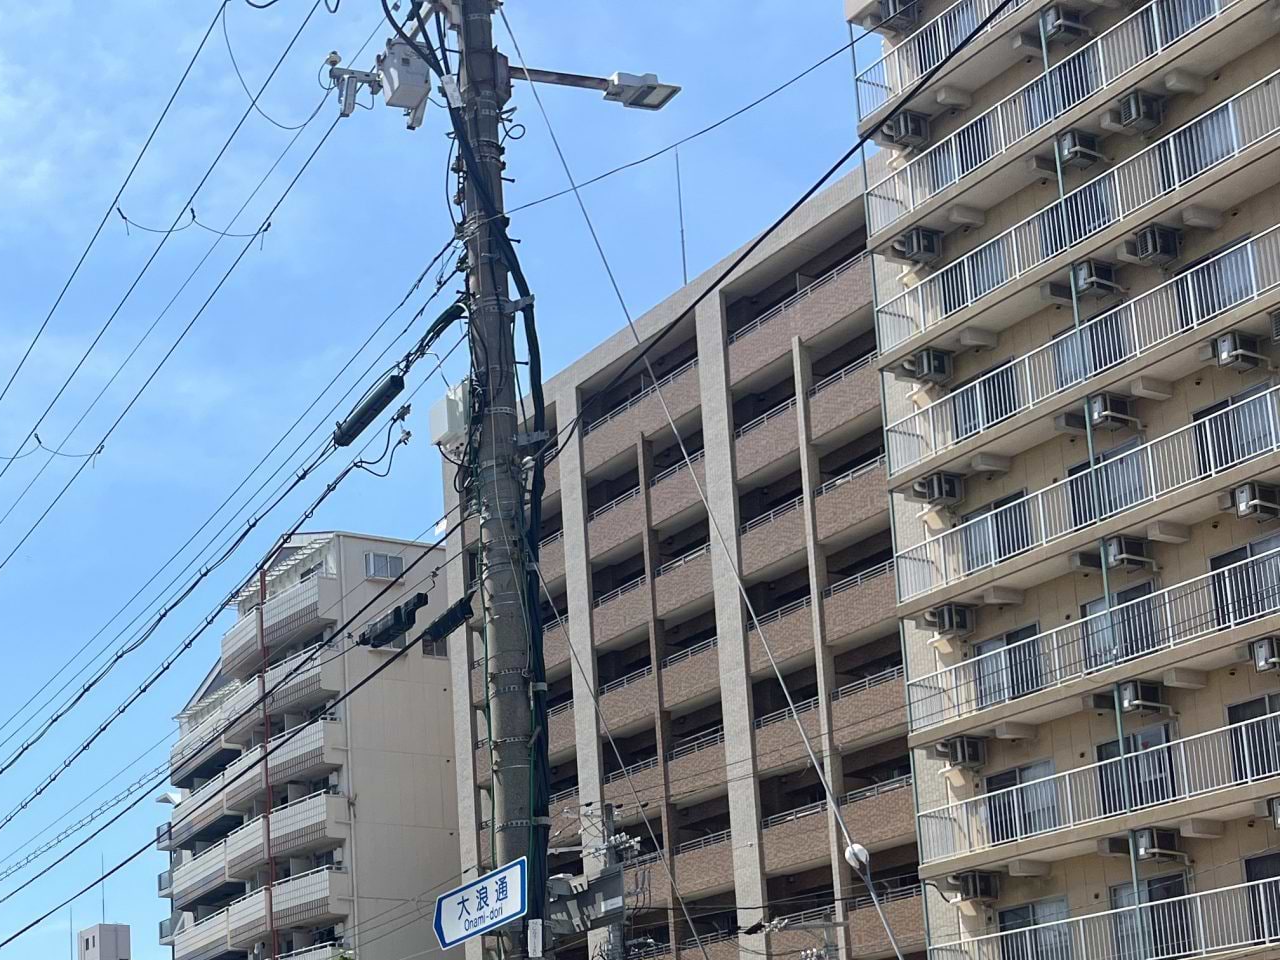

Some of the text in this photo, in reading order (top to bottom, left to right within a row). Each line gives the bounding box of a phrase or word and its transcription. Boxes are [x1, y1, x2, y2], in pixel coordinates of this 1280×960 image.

[456, 875, 509, 921] 大浪通
[463, 905, 504, 933] Onami-dori
